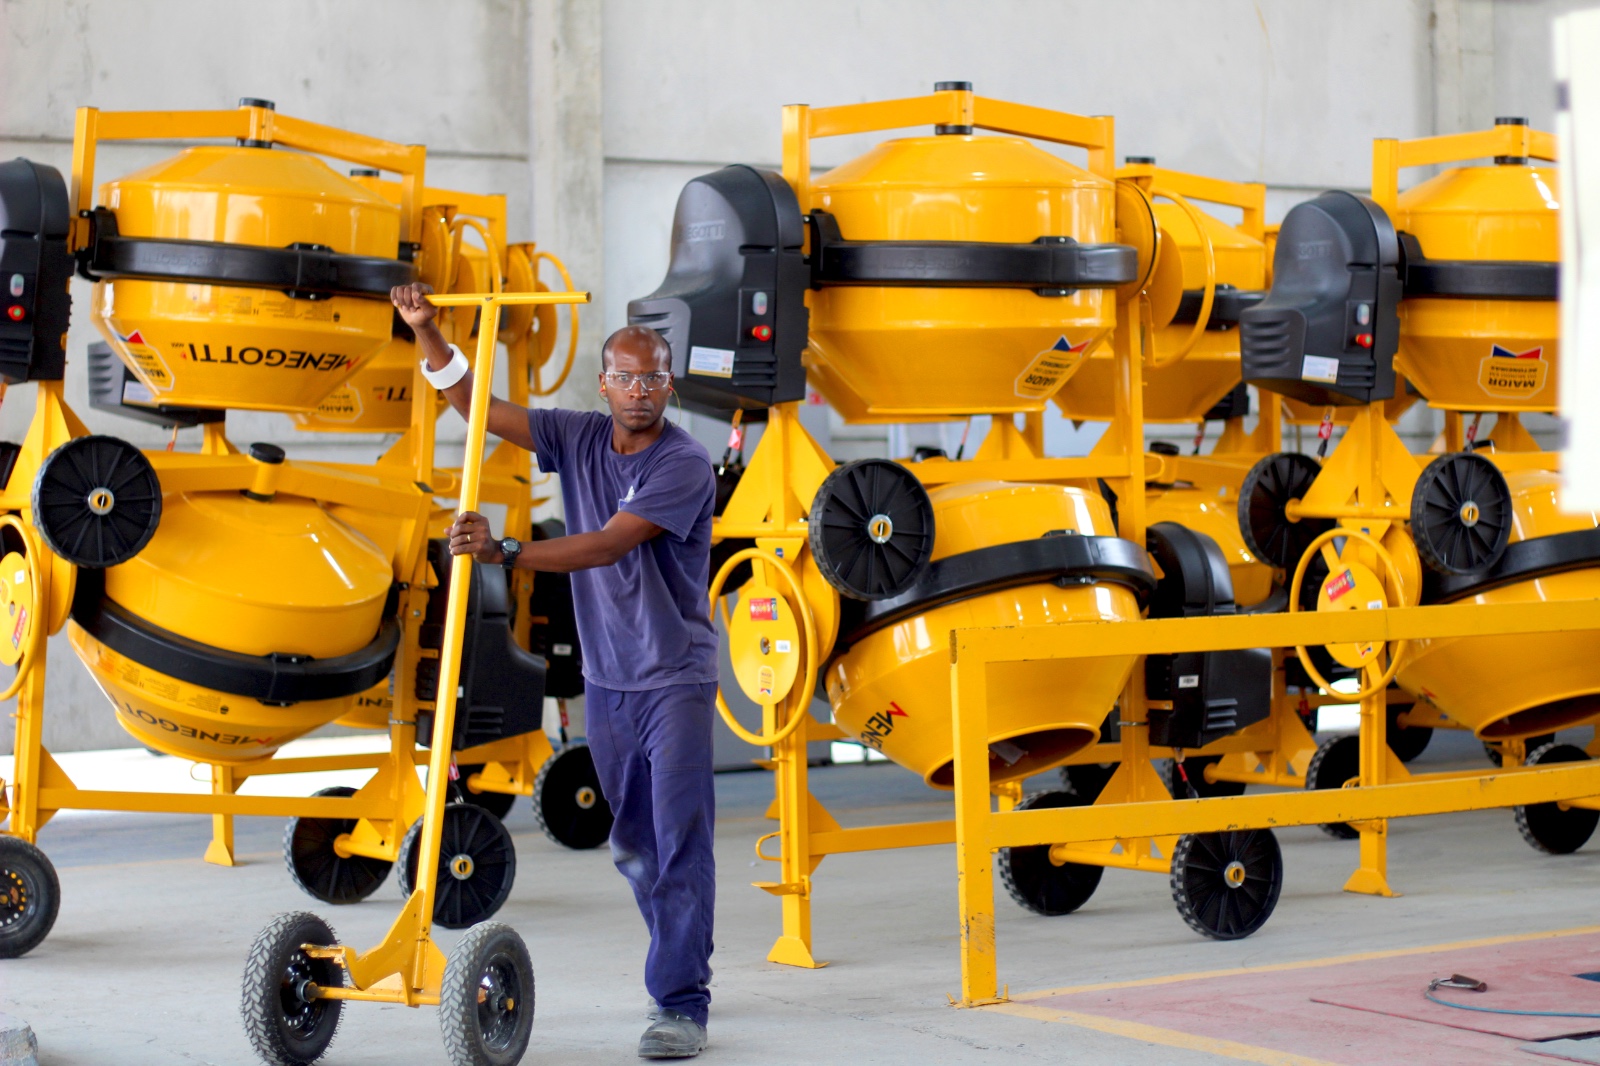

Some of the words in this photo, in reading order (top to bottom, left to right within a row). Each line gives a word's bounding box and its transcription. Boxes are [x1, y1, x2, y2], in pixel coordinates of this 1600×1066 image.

[188, 343, 360, 371] MENEGOTTI
[1025, 374, 1057, 386] MAIOR
[1488, 377, 1536, 388] MAIOR
